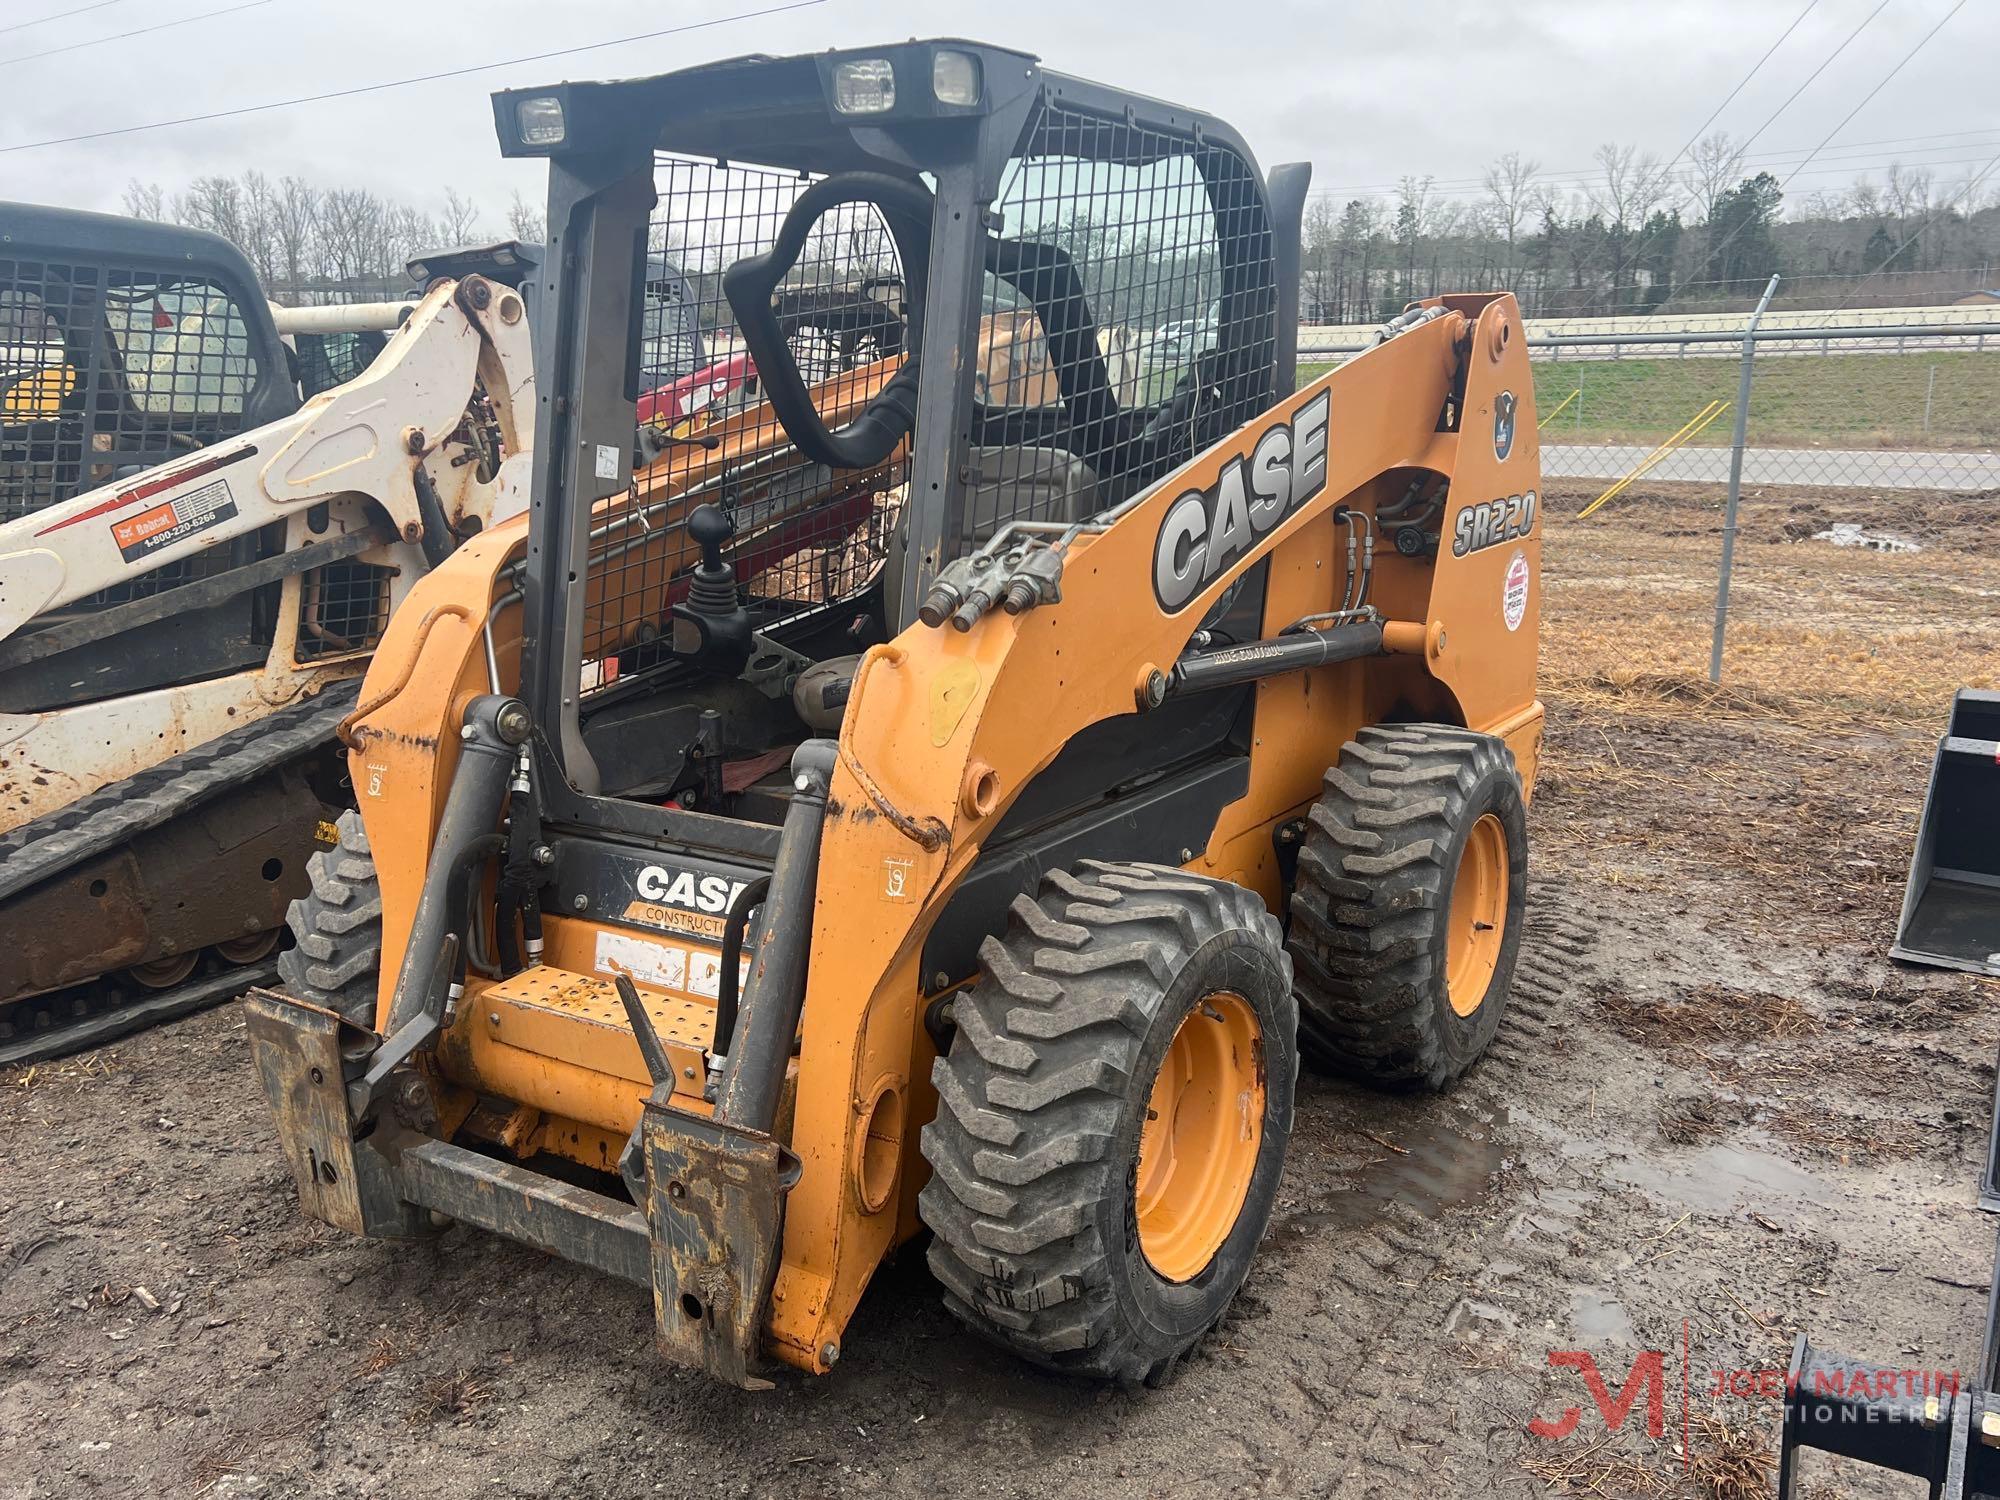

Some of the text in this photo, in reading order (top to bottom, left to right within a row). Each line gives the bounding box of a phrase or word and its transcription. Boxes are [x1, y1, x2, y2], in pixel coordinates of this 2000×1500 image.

[1154, 390, 1330, 610] CASE
[1453, 490, 1537, 558] SR220
[135, 513, 171, 536] Bobcat
[646, 907, 725, 935] CONSTRUCTI
